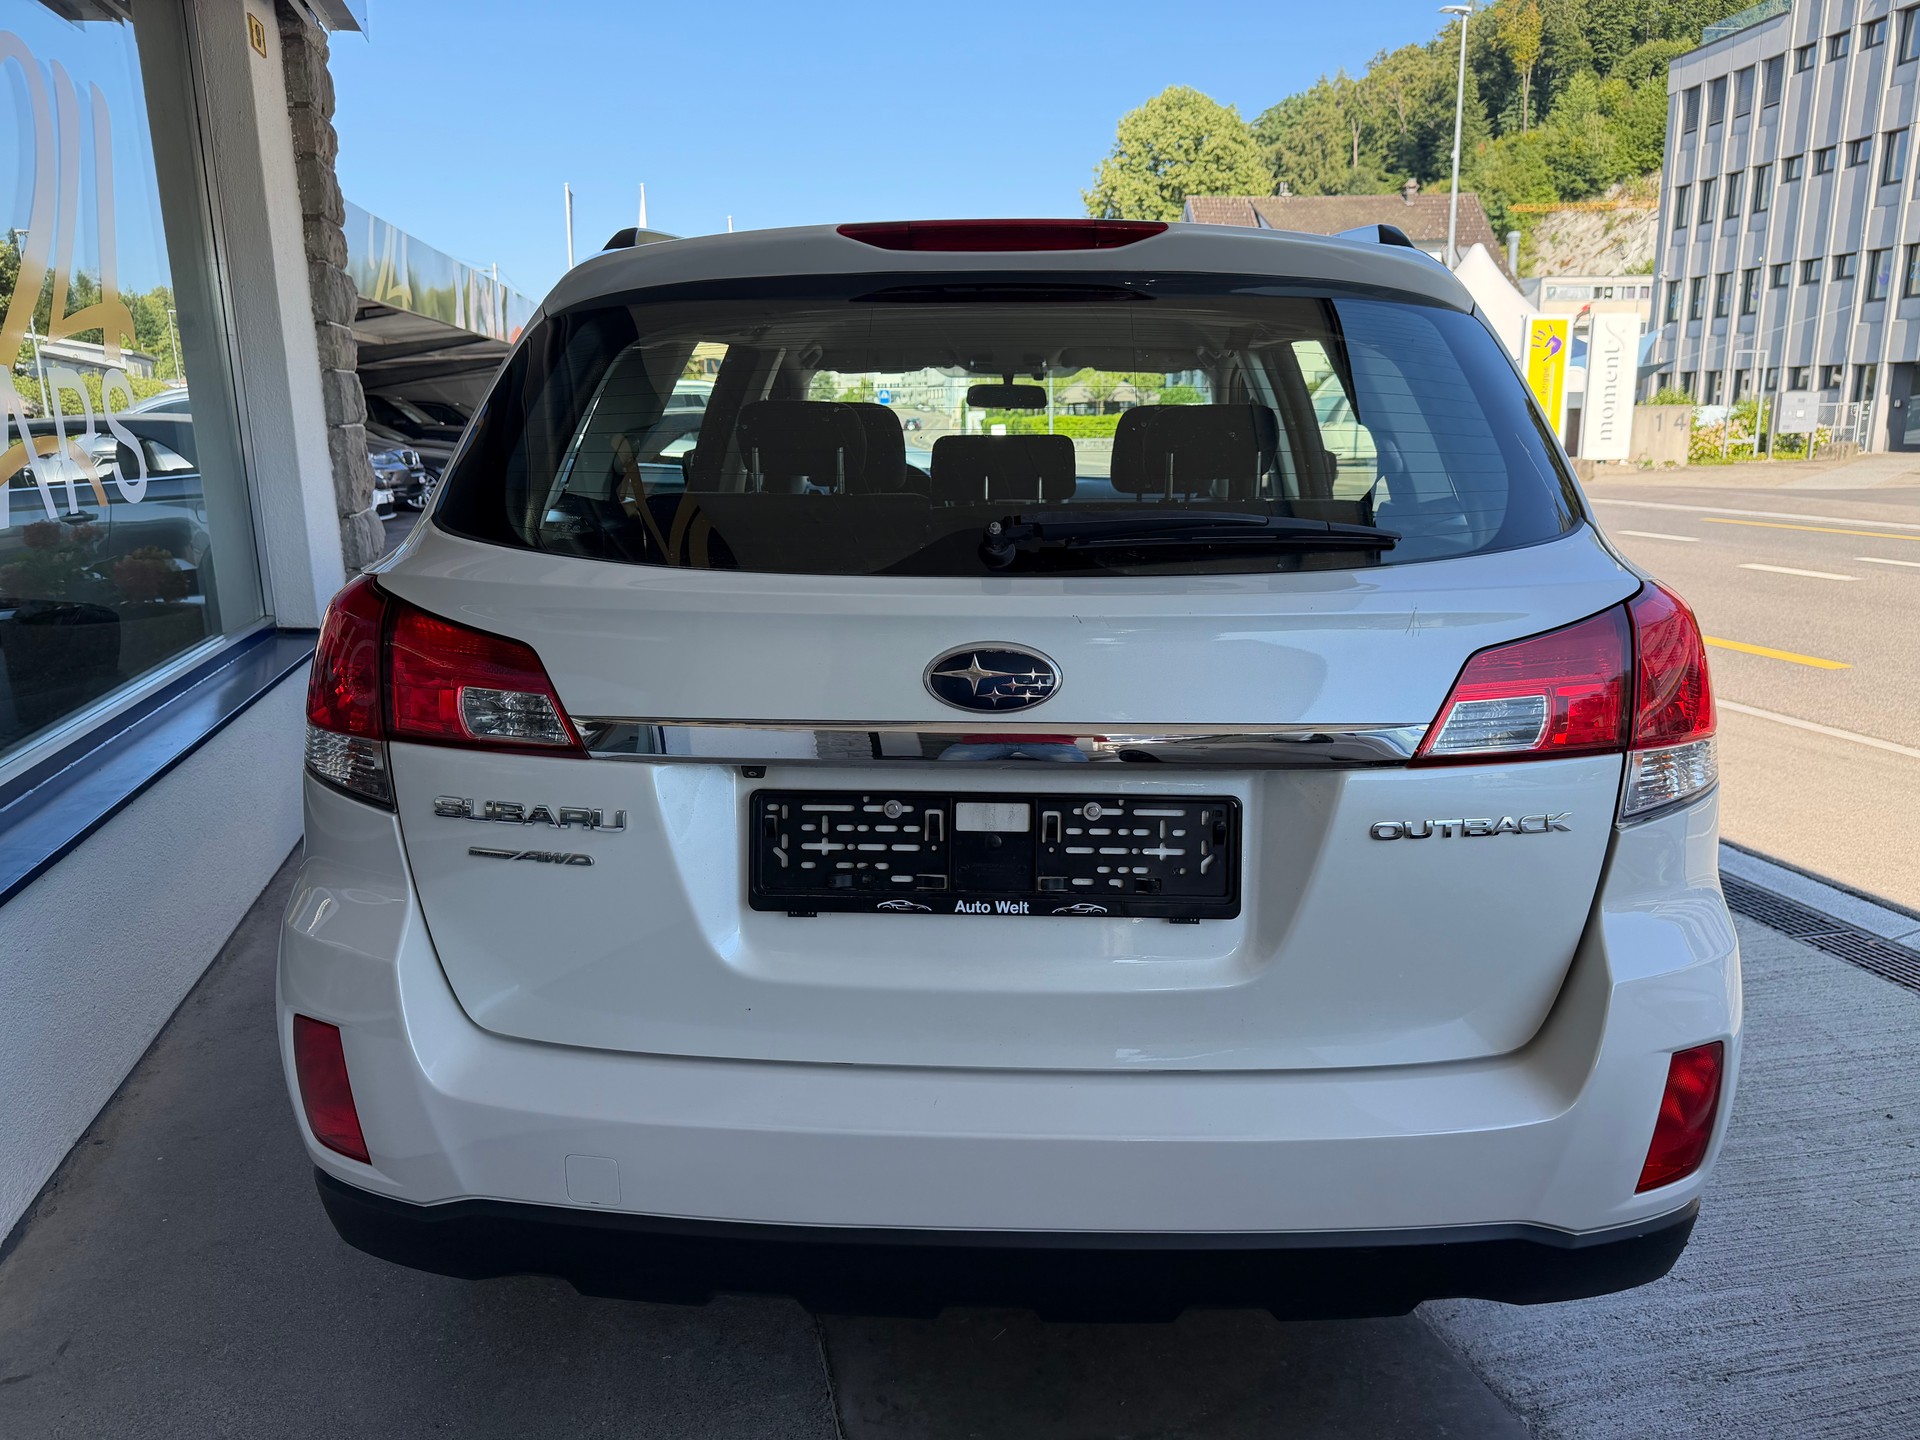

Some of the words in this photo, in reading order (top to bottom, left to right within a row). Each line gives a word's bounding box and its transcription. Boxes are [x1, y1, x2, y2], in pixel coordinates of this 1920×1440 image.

[254, 23, 262, 48] 9
[433, 795, 627, 833] SUBARU
[1370, 811, 1573, 841] OUTBACK
[954, 899, 991, 914] Auto
[995, 900, 1030, 914] Welt
